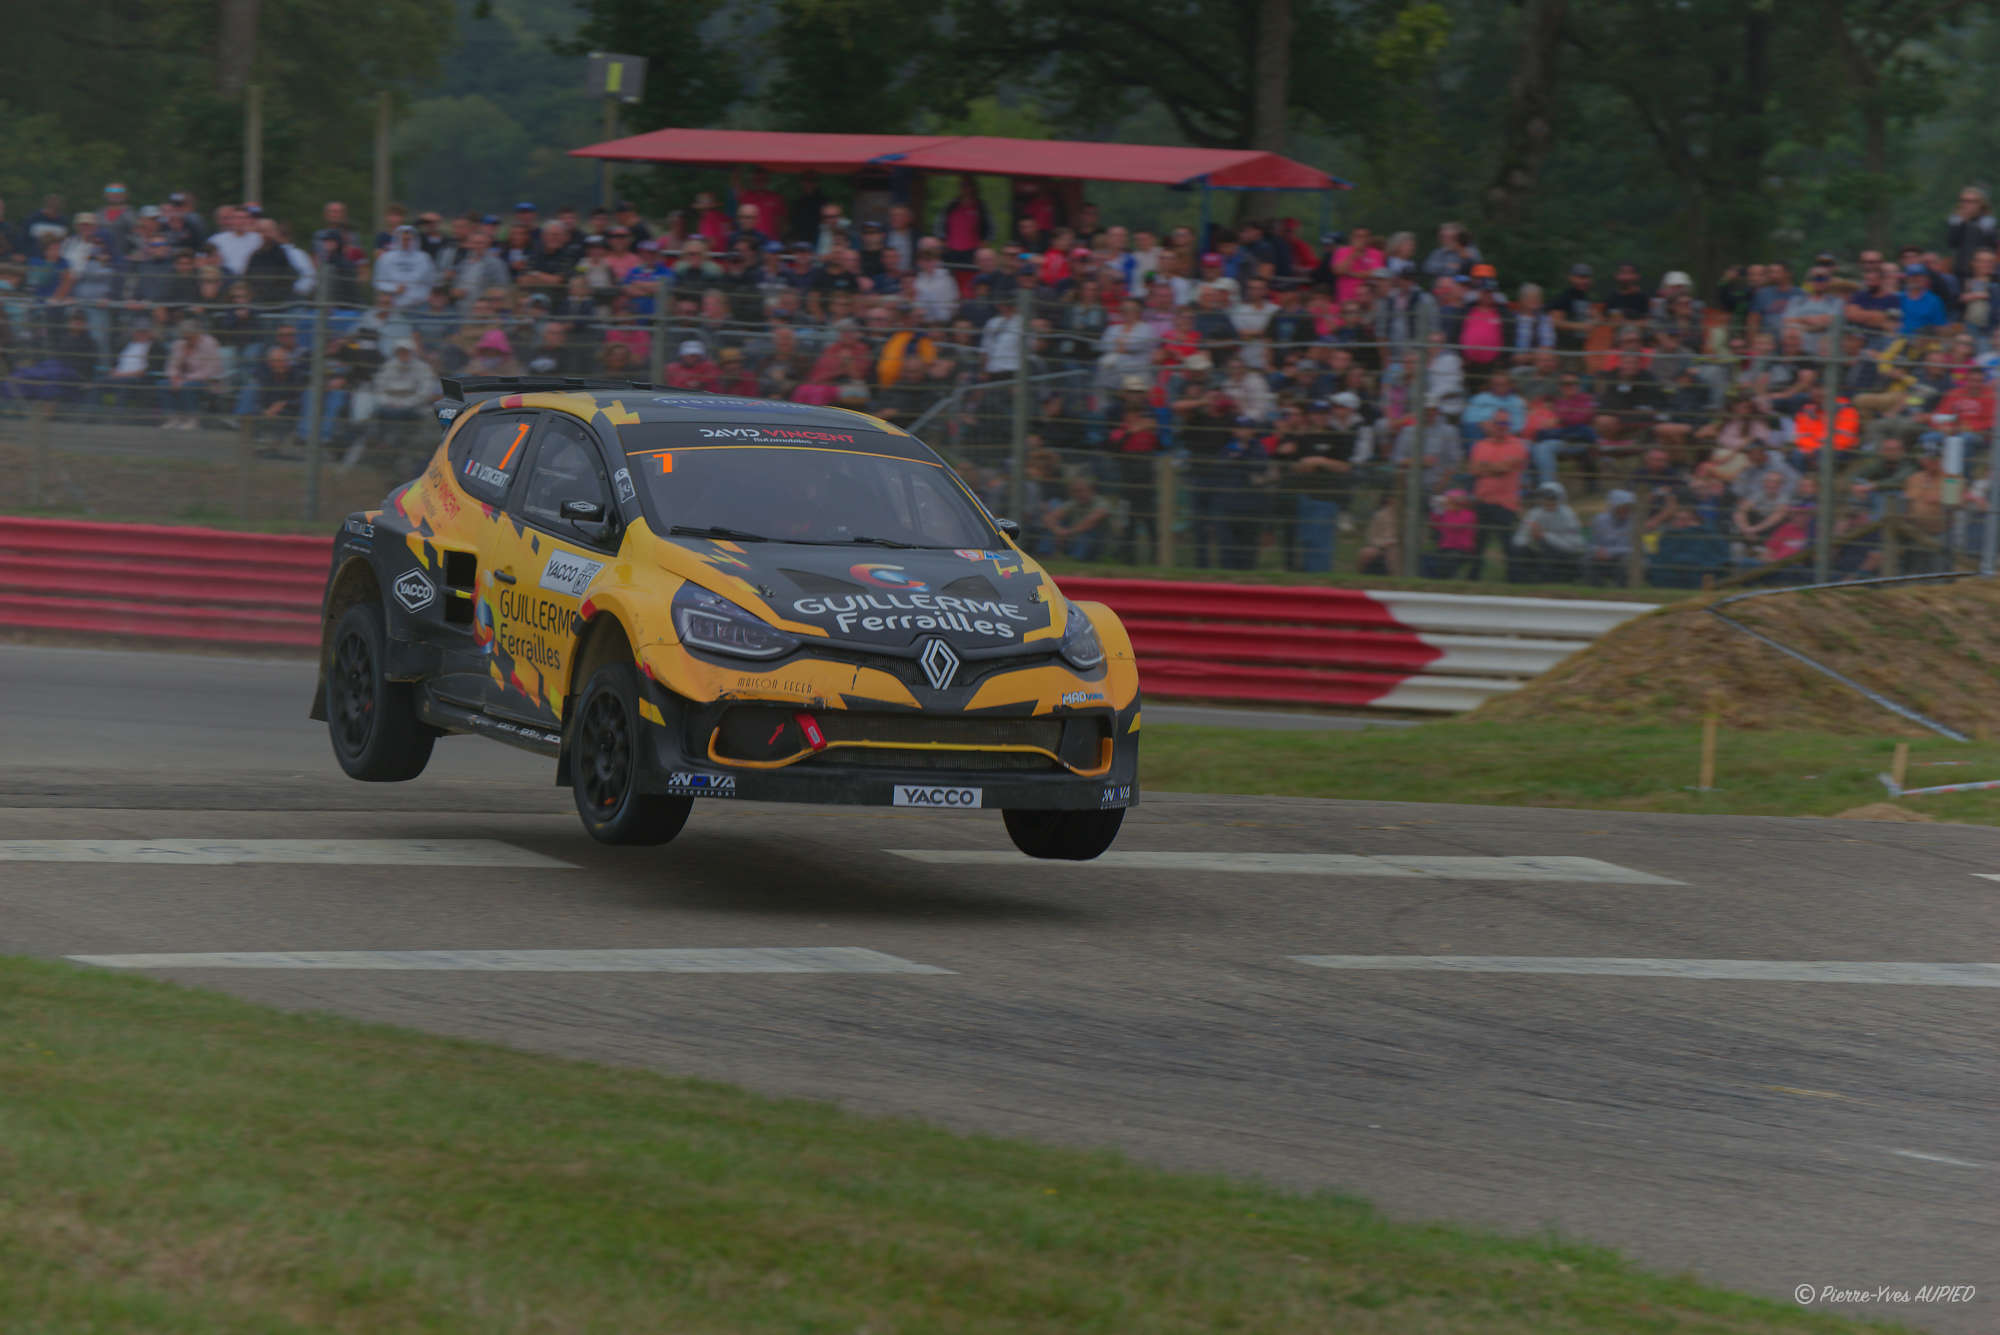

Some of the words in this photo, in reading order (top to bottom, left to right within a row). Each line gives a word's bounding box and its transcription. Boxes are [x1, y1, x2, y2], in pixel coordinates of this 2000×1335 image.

[700, 428, 760, 438] DAVID
[761, 429, 855, 444] VINCENT
[547, 560, 579, 582] YACCO
[400, 582, 430, 599] YACCO
[793, 594, 1028, 621] GUILLERME
[835, 611, 1015, 638] Ferrailles
[500, 622, 560, 670] Ferrailles
[903, 788, 974, 805] YACCO
